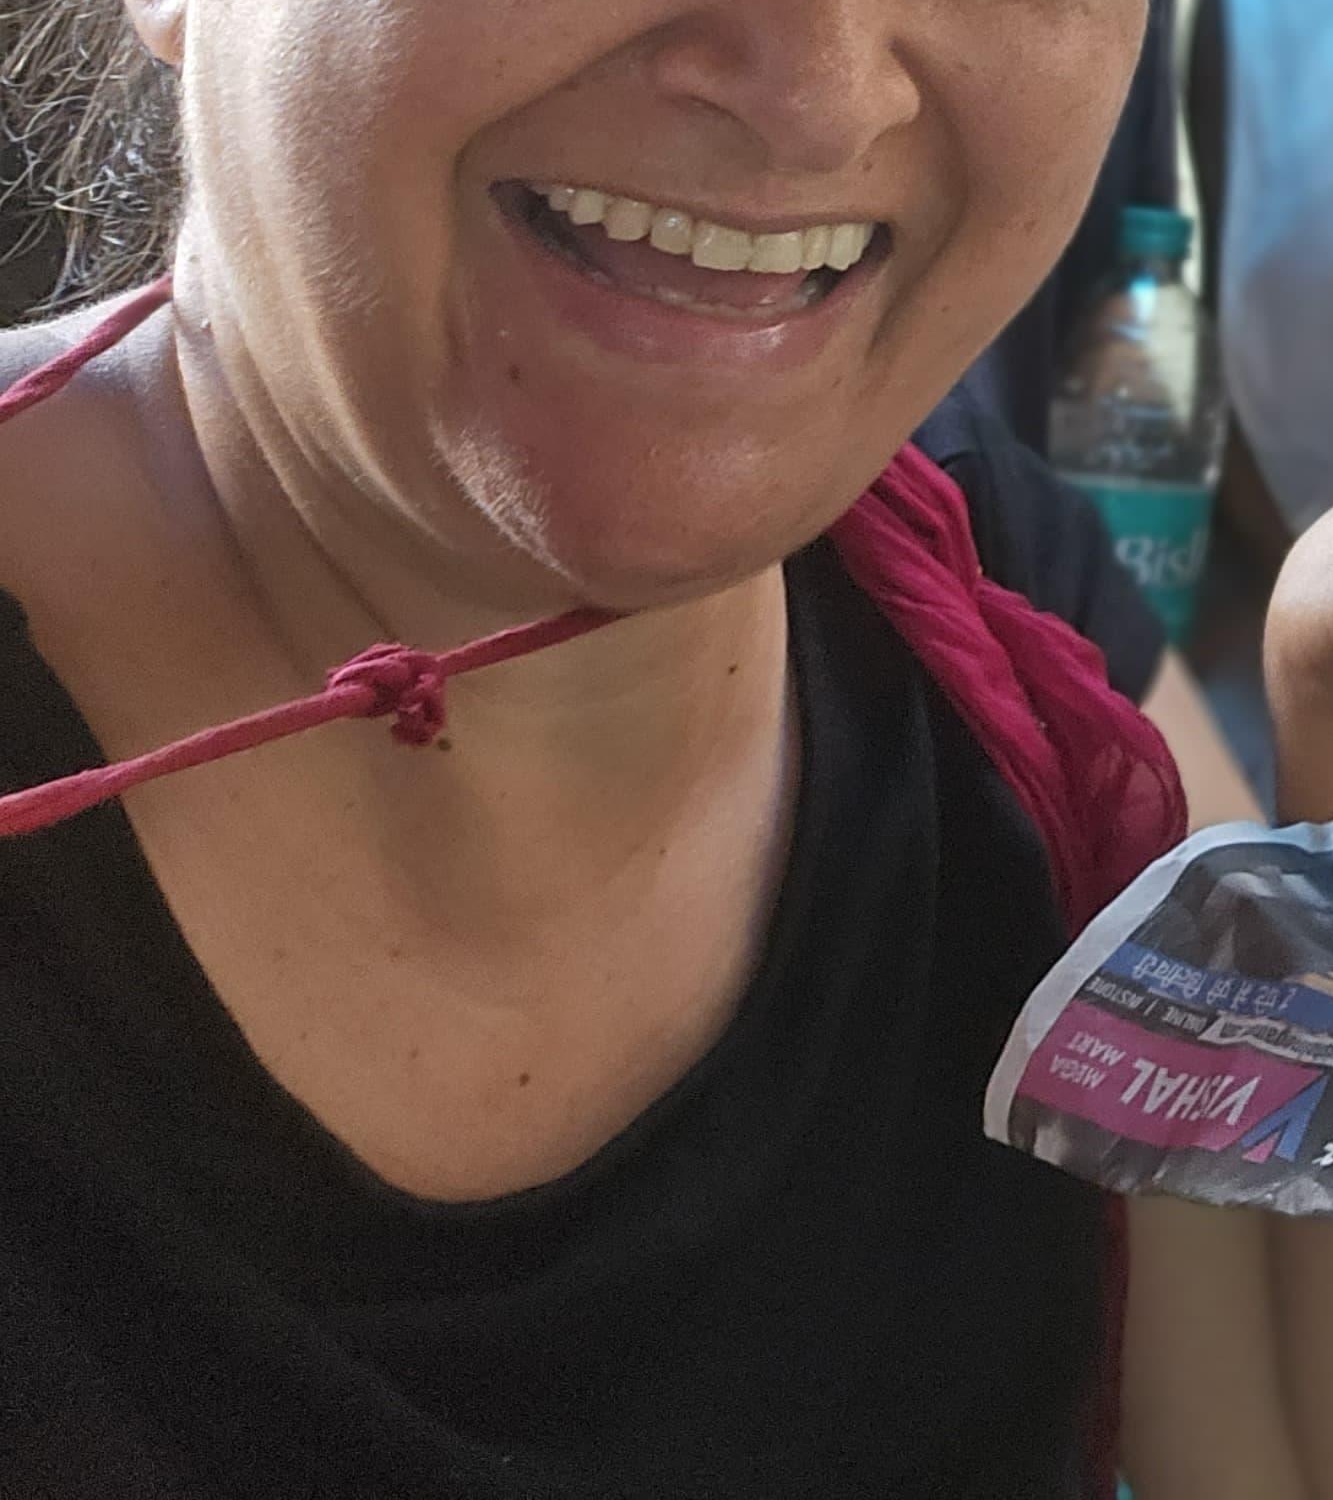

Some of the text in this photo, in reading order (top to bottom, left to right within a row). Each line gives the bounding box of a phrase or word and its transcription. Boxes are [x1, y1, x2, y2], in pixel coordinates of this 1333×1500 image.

[1065, 1030, 1127, 1067] MART
[1048, 1052, 1108, 1090] MEGA
[1119, 1057, 1262, 1127] VISHAL
